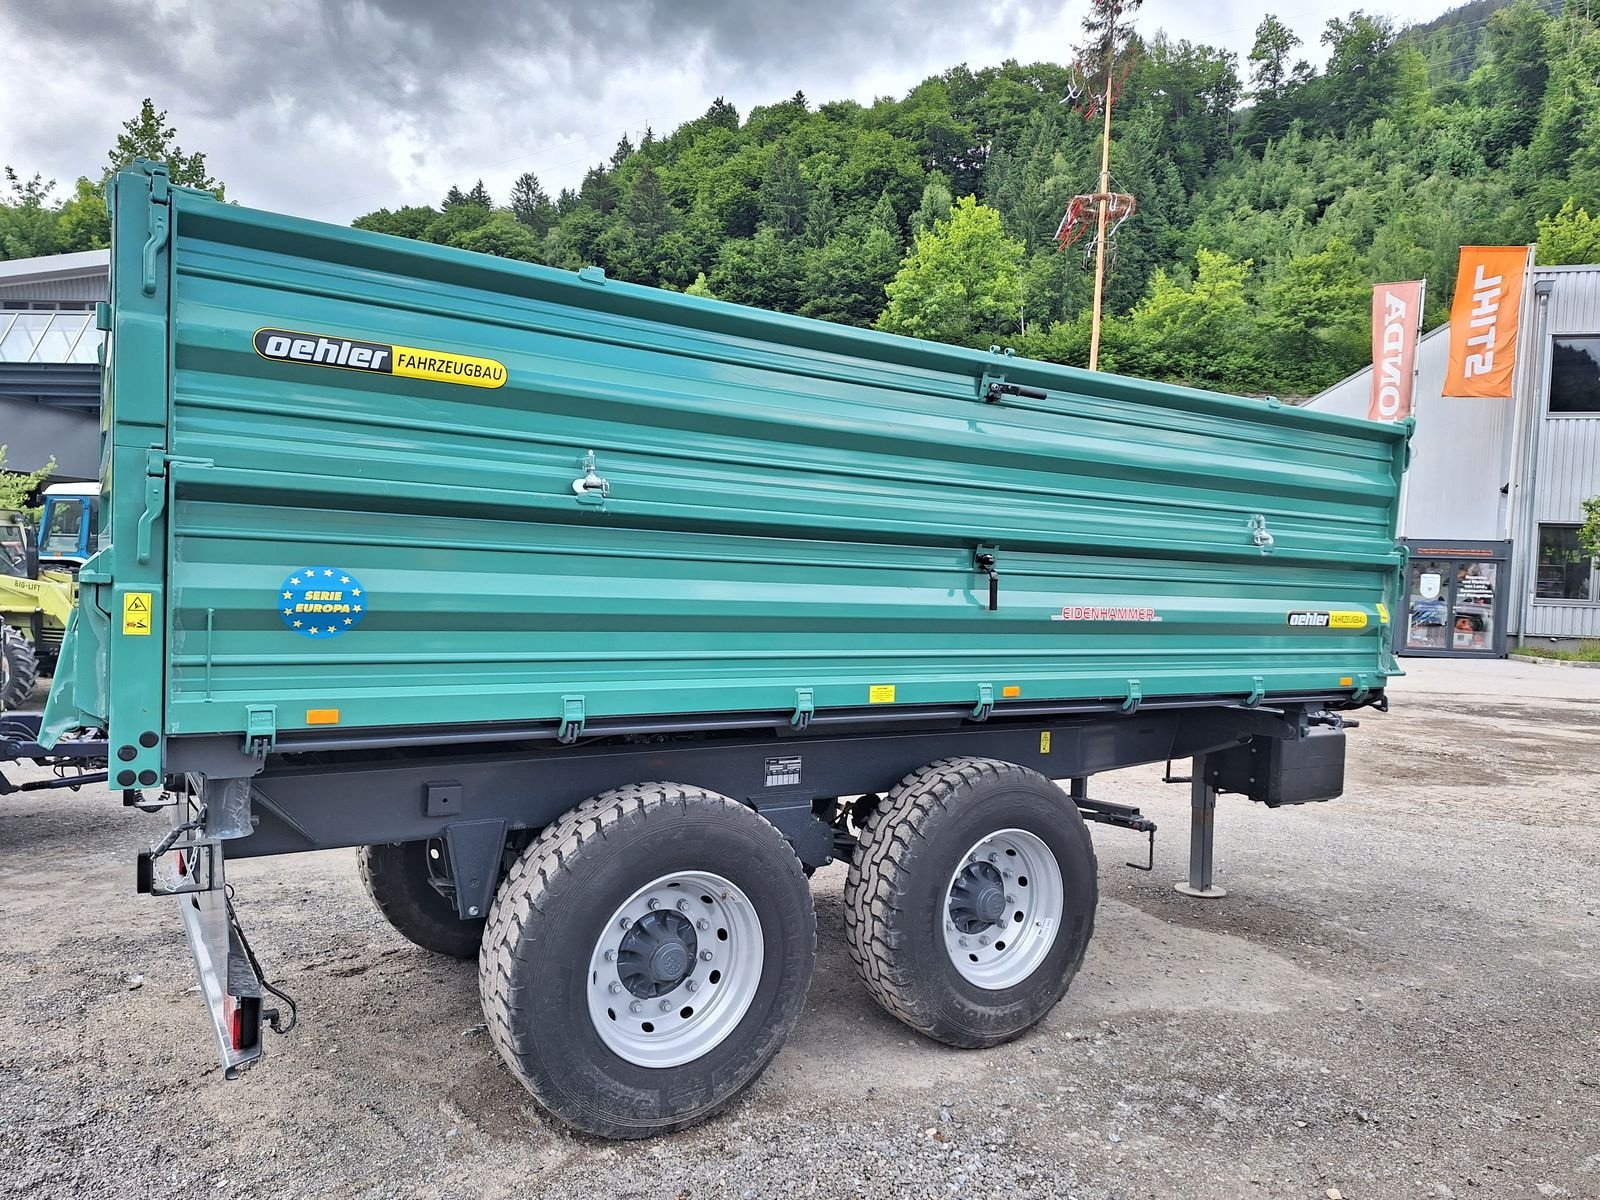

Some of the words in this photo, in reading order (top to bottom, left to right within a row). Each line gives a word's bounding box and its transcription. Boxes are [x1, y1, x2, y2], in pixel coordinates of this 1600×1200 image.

[264, 335, 389, 370] oehler
[397, 353, 502, 381] FAHRZEUGBAU
[14, 580, 40, 592] BIG-LIFT
[304, 591, 342, 601] SERIE
[295, 603, 350, 613] EUROPA
[1063, 607, 1154, 620] EIDENHAMMER
[1289, 612, 1329, 626] oehler
